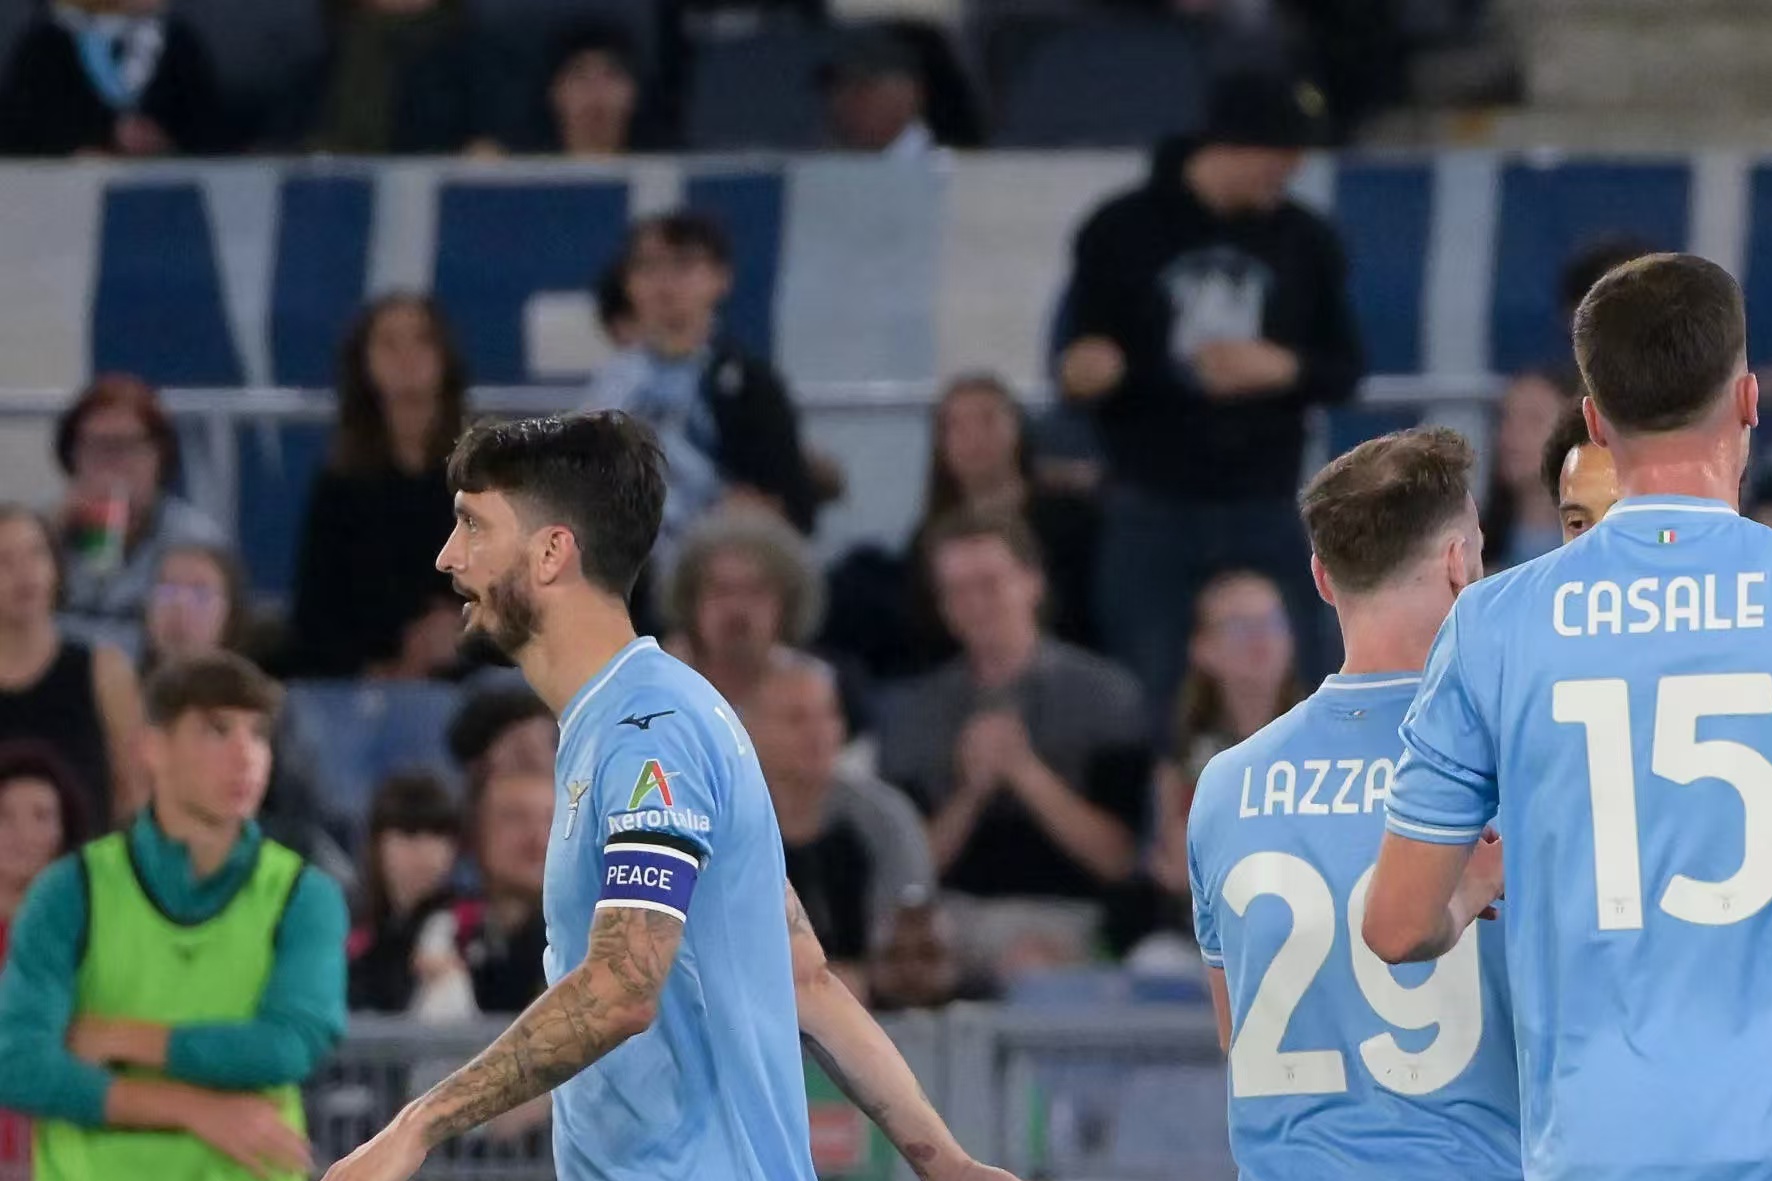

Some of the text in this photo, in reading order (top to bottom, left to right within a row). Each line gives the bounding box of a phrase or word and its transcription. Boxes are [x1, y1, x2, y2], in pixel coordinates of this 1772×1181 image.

[1553, 572, 1767, 637] CASALE
[1239, 757, 1396, 819] LAZZA
[606, 864, 674, 891] PEACE
[1222, 851, 1483, 1098] 29
